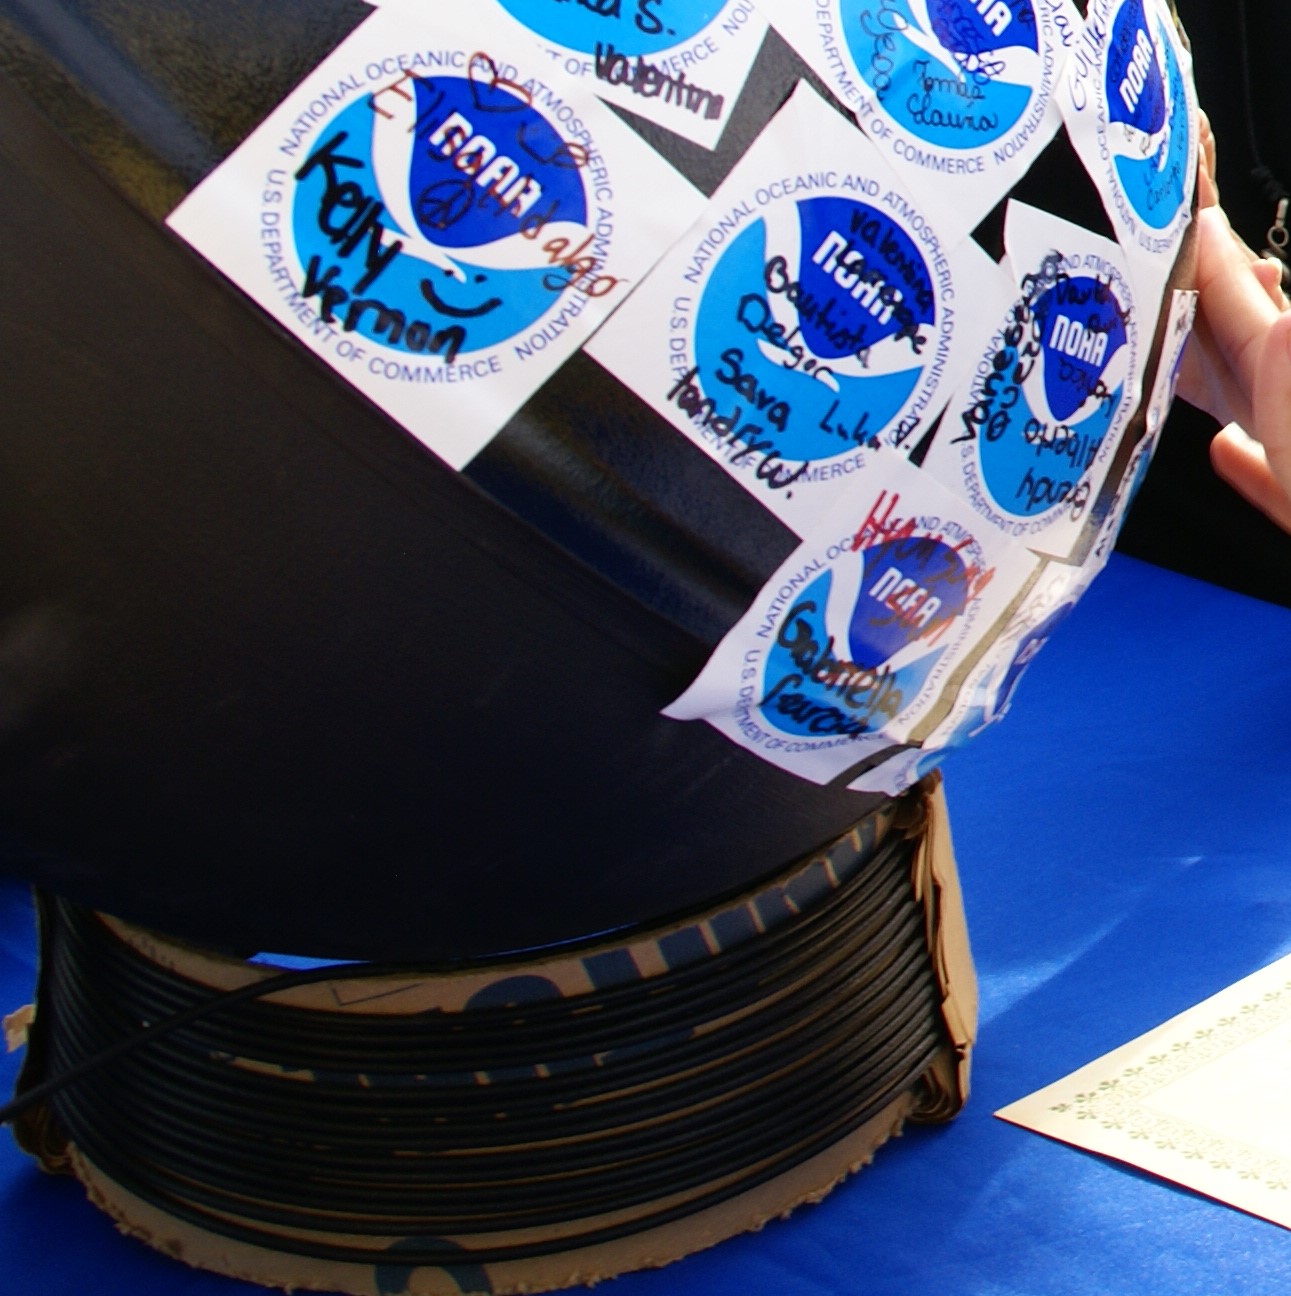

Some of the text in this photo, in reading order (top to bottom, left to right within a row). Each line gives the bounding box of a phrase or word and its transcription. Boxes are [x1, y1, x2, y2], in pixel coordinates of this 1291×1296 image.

[564, 56, 593, 78] OF
[993, 41, 1057, 166] ADMINISTRATION
[1119, 28, 1155, 114] NOAA
[279, 74, 366, 157] NATIONAL
[365, 50, 467, 82] OCEANIC
[523, 77, 614, 202] ATMOSPHERIC
[429, 112, 543, 218] NOAA
[869, 117, 895, 141] OF
[892, 138, 986, 175] COMMERCE
[294, 130, 404, 296] Kelly
[683, 200, 757, 285] NATIONAL
[754, 171, 839, 207] OCEANIC
[841, 174, 881, 198] AND
[881, 189, 956, 302] ATMOSPHERIC
[261, 211, 339, 344] DEPARTMENT
[334, 339, 367, 363] OF
[367, 353, 505, 385] COMMERCE
[302, 255, 467, 365] Vernon
[756, 557, 825, 640] NATIONAL
